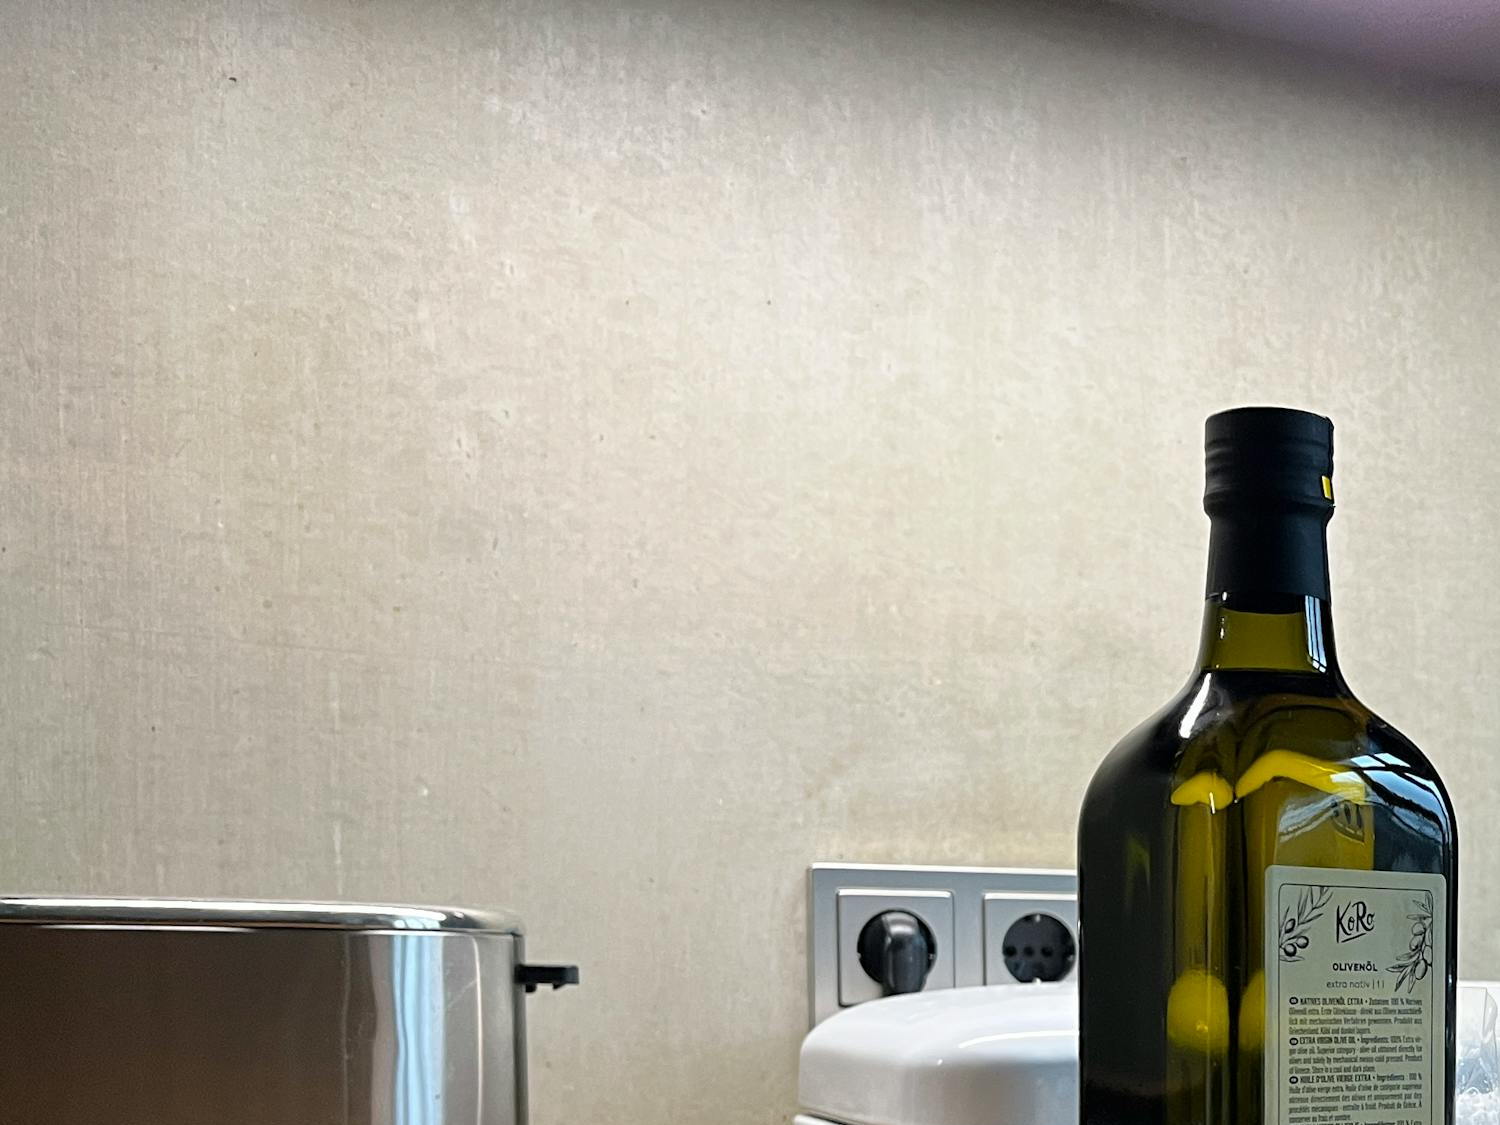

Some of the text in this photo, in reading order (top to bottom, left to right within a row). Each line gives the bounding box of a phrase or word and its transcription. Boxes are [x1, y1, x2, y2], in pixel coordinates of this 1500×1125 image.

[1336, 901, 1375, 943] KoRo
[1332, 961, 1377, 971] OLIVENÖL
[1327, 980, 1347, 988] extra
